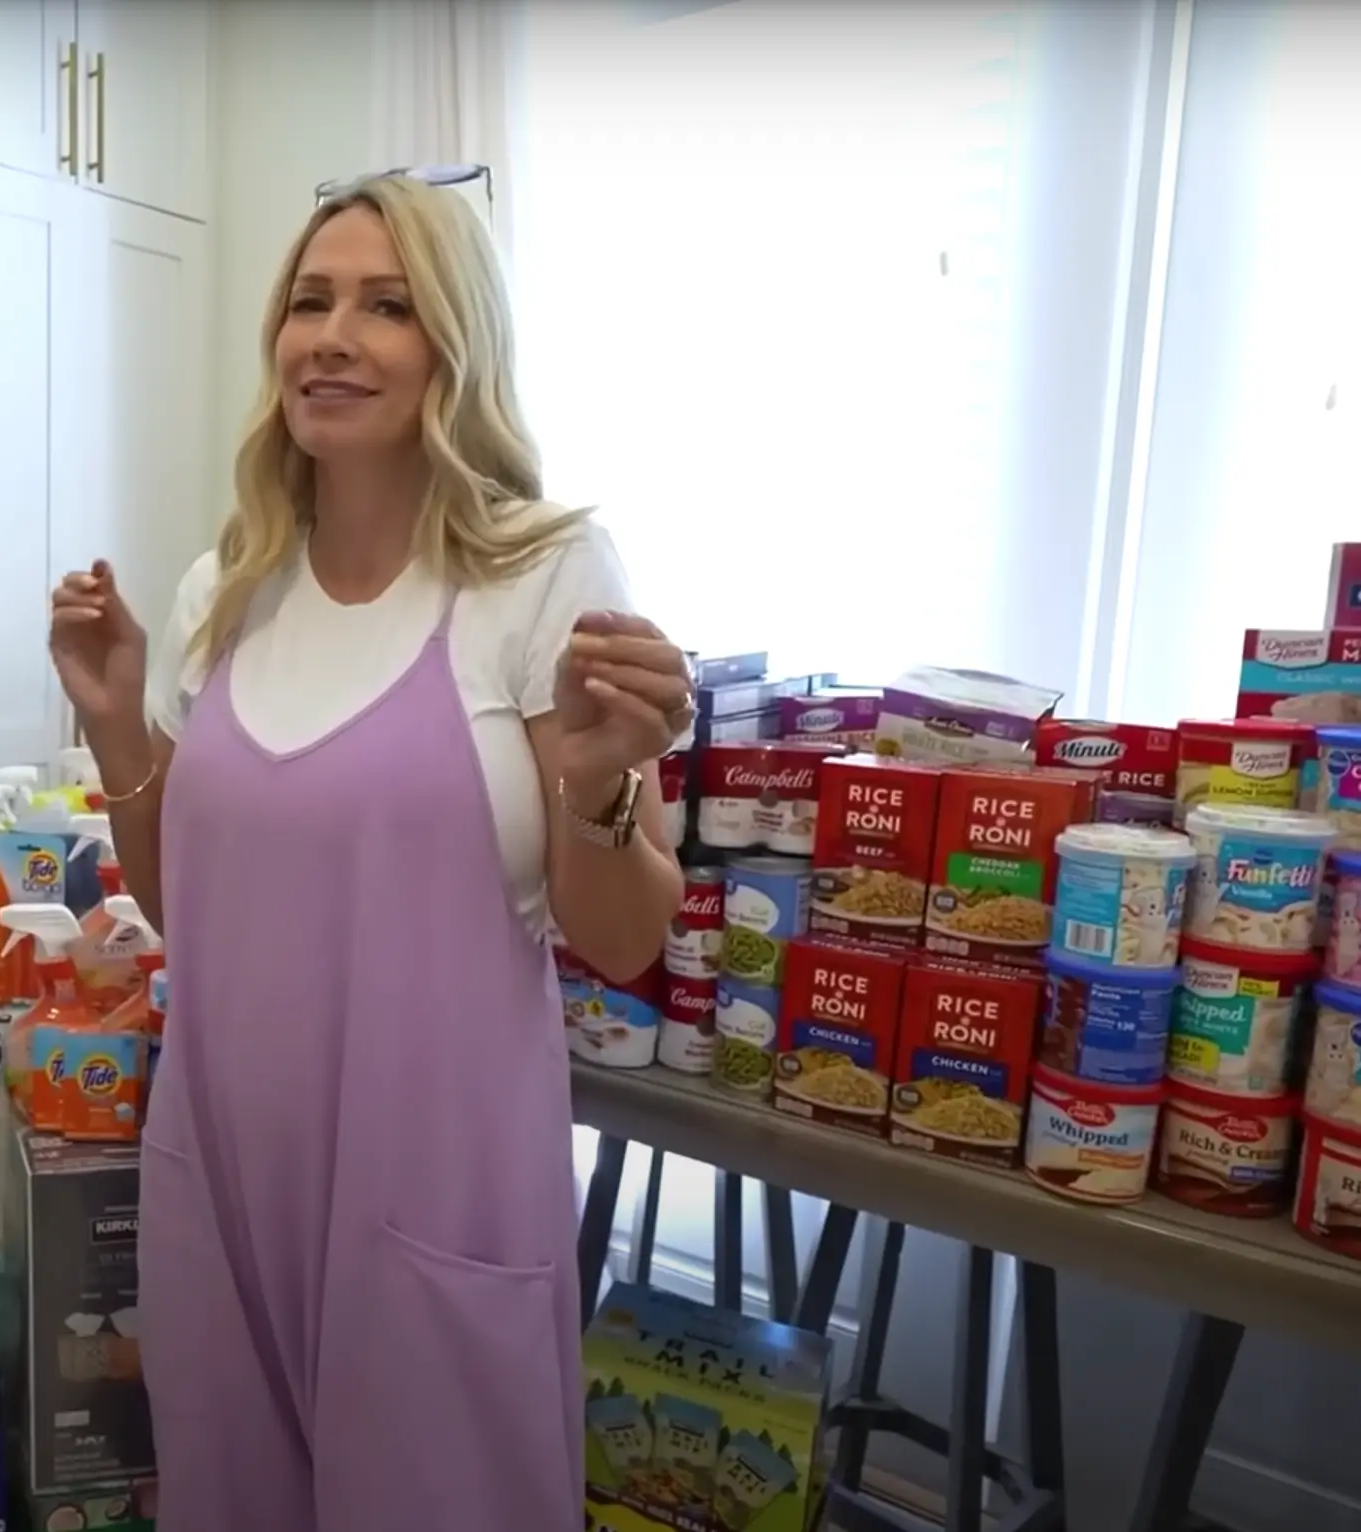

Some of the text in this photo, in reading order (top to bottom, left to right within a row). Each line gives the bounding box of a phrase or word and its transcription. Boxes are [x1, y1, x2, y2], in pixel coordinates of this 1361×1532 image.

[1057, 739, 1124, 759] Minute
[723, 764, 816, 790] Campbell's
[1118, 771, 1165, 787] RICE
[847, 784, 904, 806] RICE
[972, 796, 1036, 819] RICE
[845, 810, 901, 833] RONI
[969, 824, 1032, 848] RONI
[855, 844, 884, 857] BEEF
[970, 856, 1021, 870] CHEDDAR
[1227, 858, 1312, 888] Funfetti
[813, 967, 870, 995] RICE
[810, 993, 867, 1021] RONI
[936, 993, 1000, 1020] RICE
[808, 1025, 860, 1046] CHICKEN
[932, 1020, 997, 1048] RONI
[82, 1064, 119, 1091] Tide
[930, 1055, 990, 1077] CHICKEN
[1047, 1115, 1129, 1148] Whipped
[1179, 1128, 1216, 1153] Rich
[1219, 1142, 1233, 1157] &
